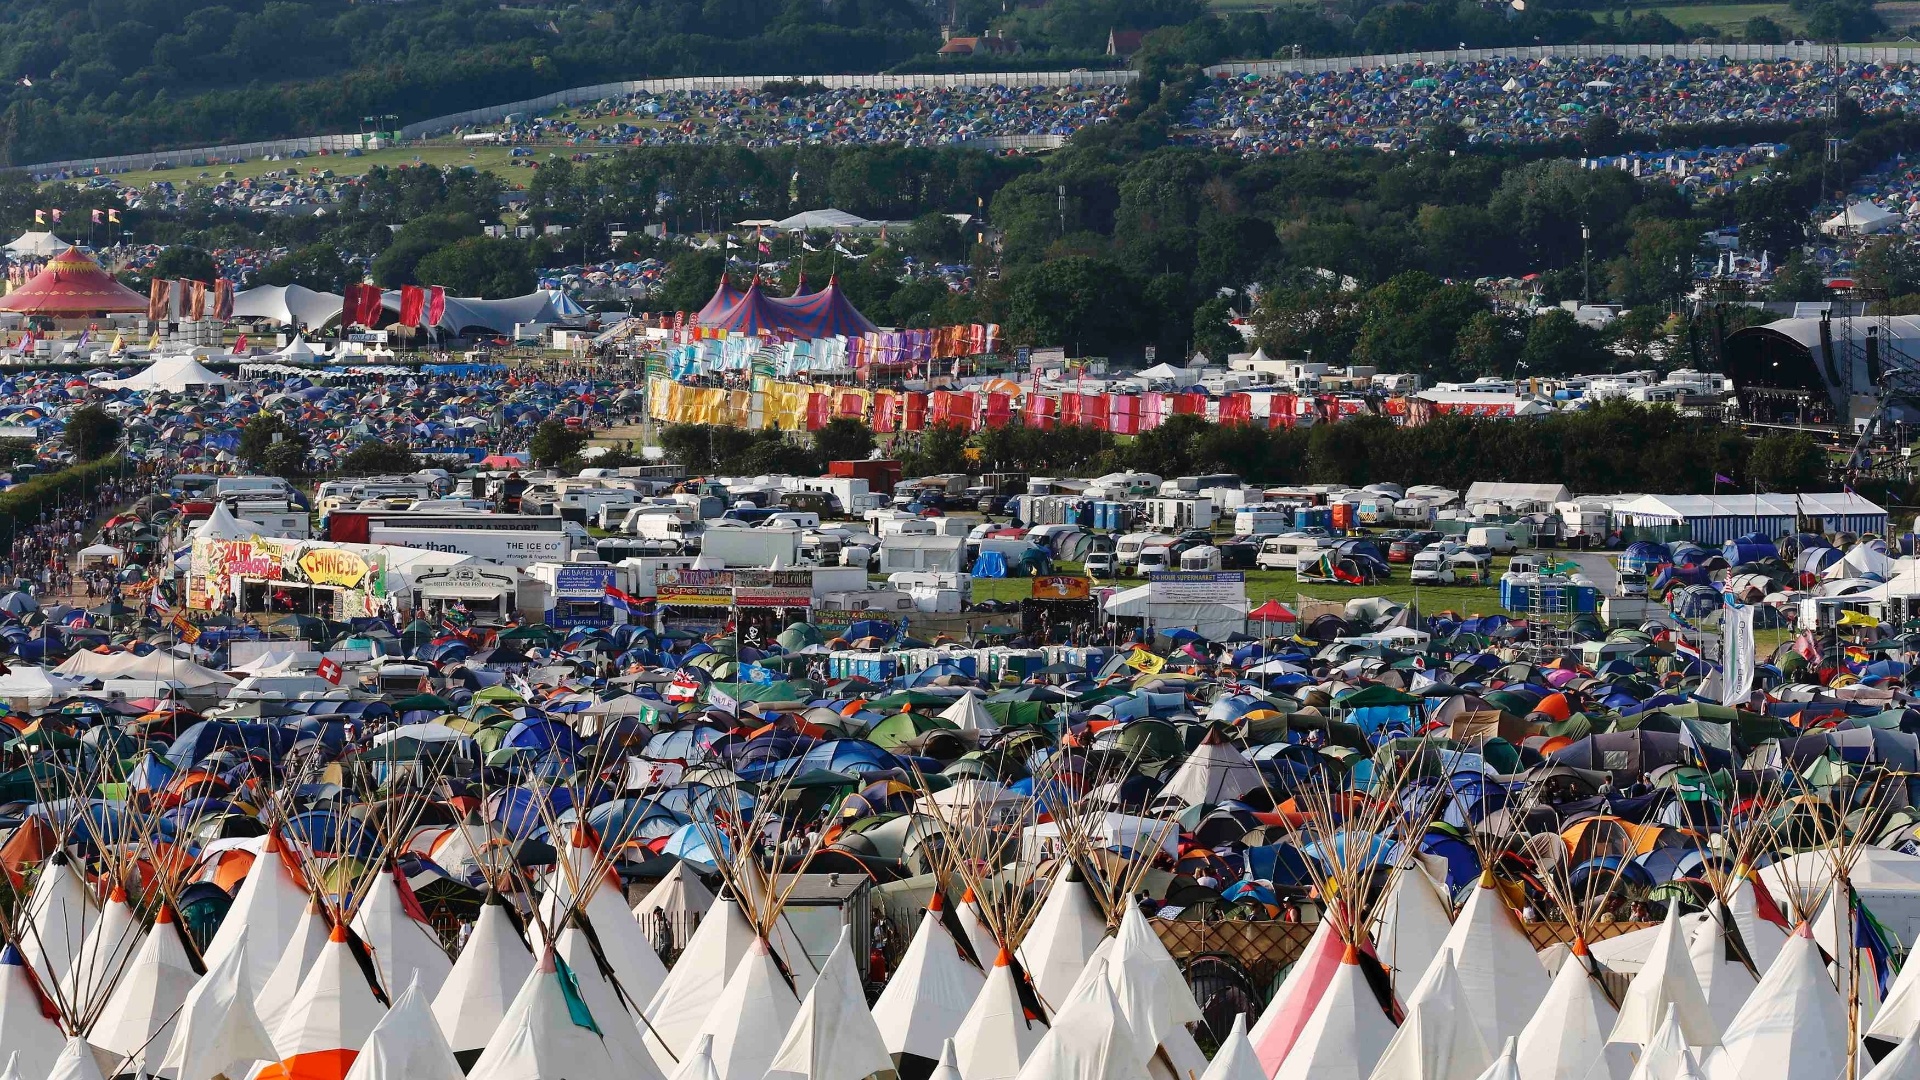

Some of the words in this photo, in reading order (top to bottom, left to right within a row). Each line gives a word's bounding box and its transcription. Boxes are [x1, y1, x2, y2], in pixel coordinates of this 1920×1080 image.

[223, 542, 238, 563] 24
[239, 542, 252, 563] HR
[266, 544, 281, 554] HOT!
[506, 542, 524, 550] THE
[526, 542, 542, 550] ICE
[544, 543, 558, 551] CO
[229, 557, 269, 575] BREAKFAST
[306, 552, 359, 576] CHINESE
